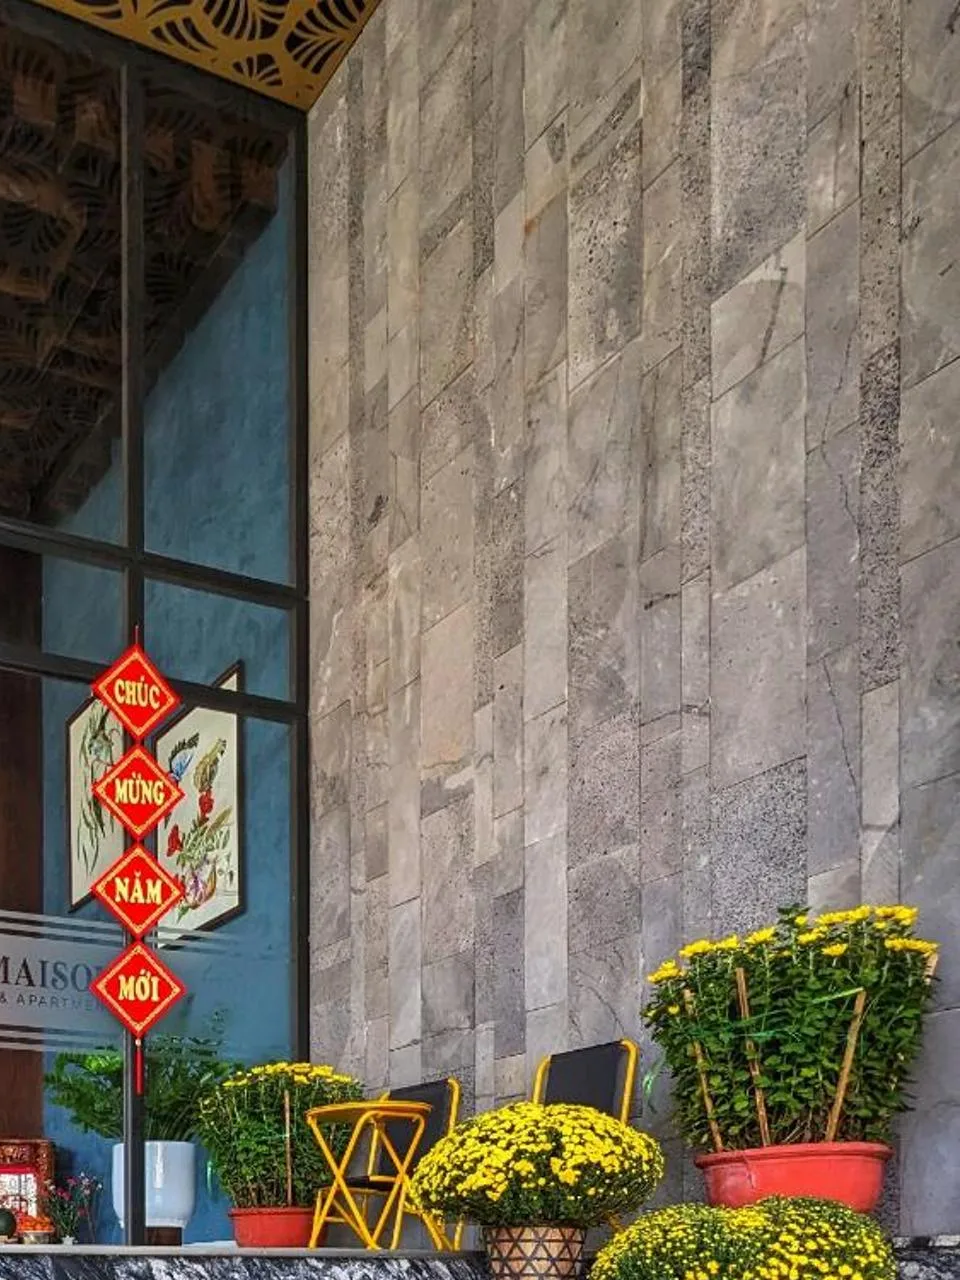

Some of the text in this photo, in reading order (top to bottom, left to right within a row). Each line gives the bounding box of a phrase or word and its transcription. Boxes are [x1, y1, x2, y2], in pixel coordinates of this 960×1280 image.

[114, 675, 161, 710] CHÚC
[114, 870, 163, 905] NĂM
[117, 968, 160, 1002] MỚI
